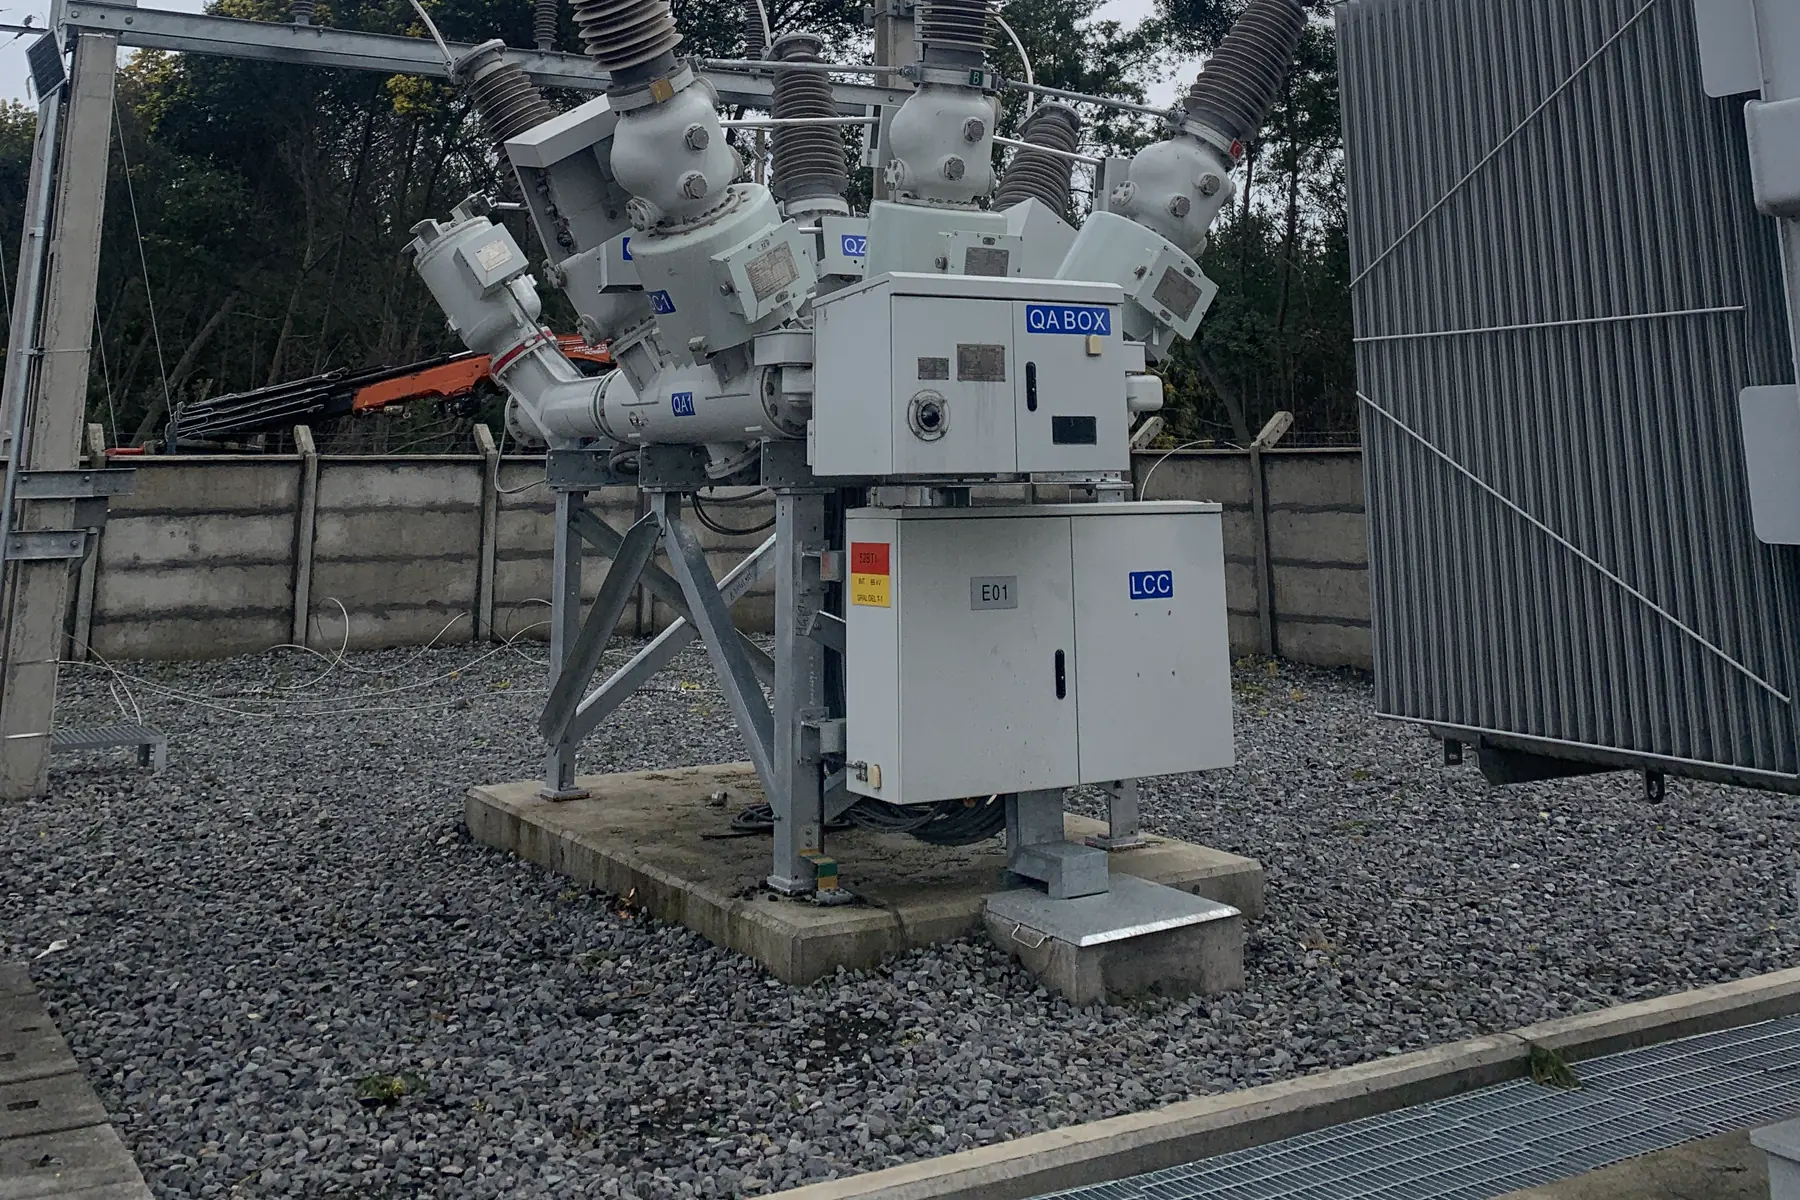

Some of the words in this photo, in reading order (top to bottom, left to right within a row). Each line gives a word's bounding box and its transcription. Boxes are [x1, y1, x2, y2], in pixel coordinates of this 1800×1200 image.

[973, 71, 980, 85] B
[1030, 309, 1060, 330] QA
[1063, 310, 1107, 331] BOX
[673, 395, 693, 413] QA1
[982, 584, 1008, 601] E01
[1131, 574, 1170, 595] LCC
